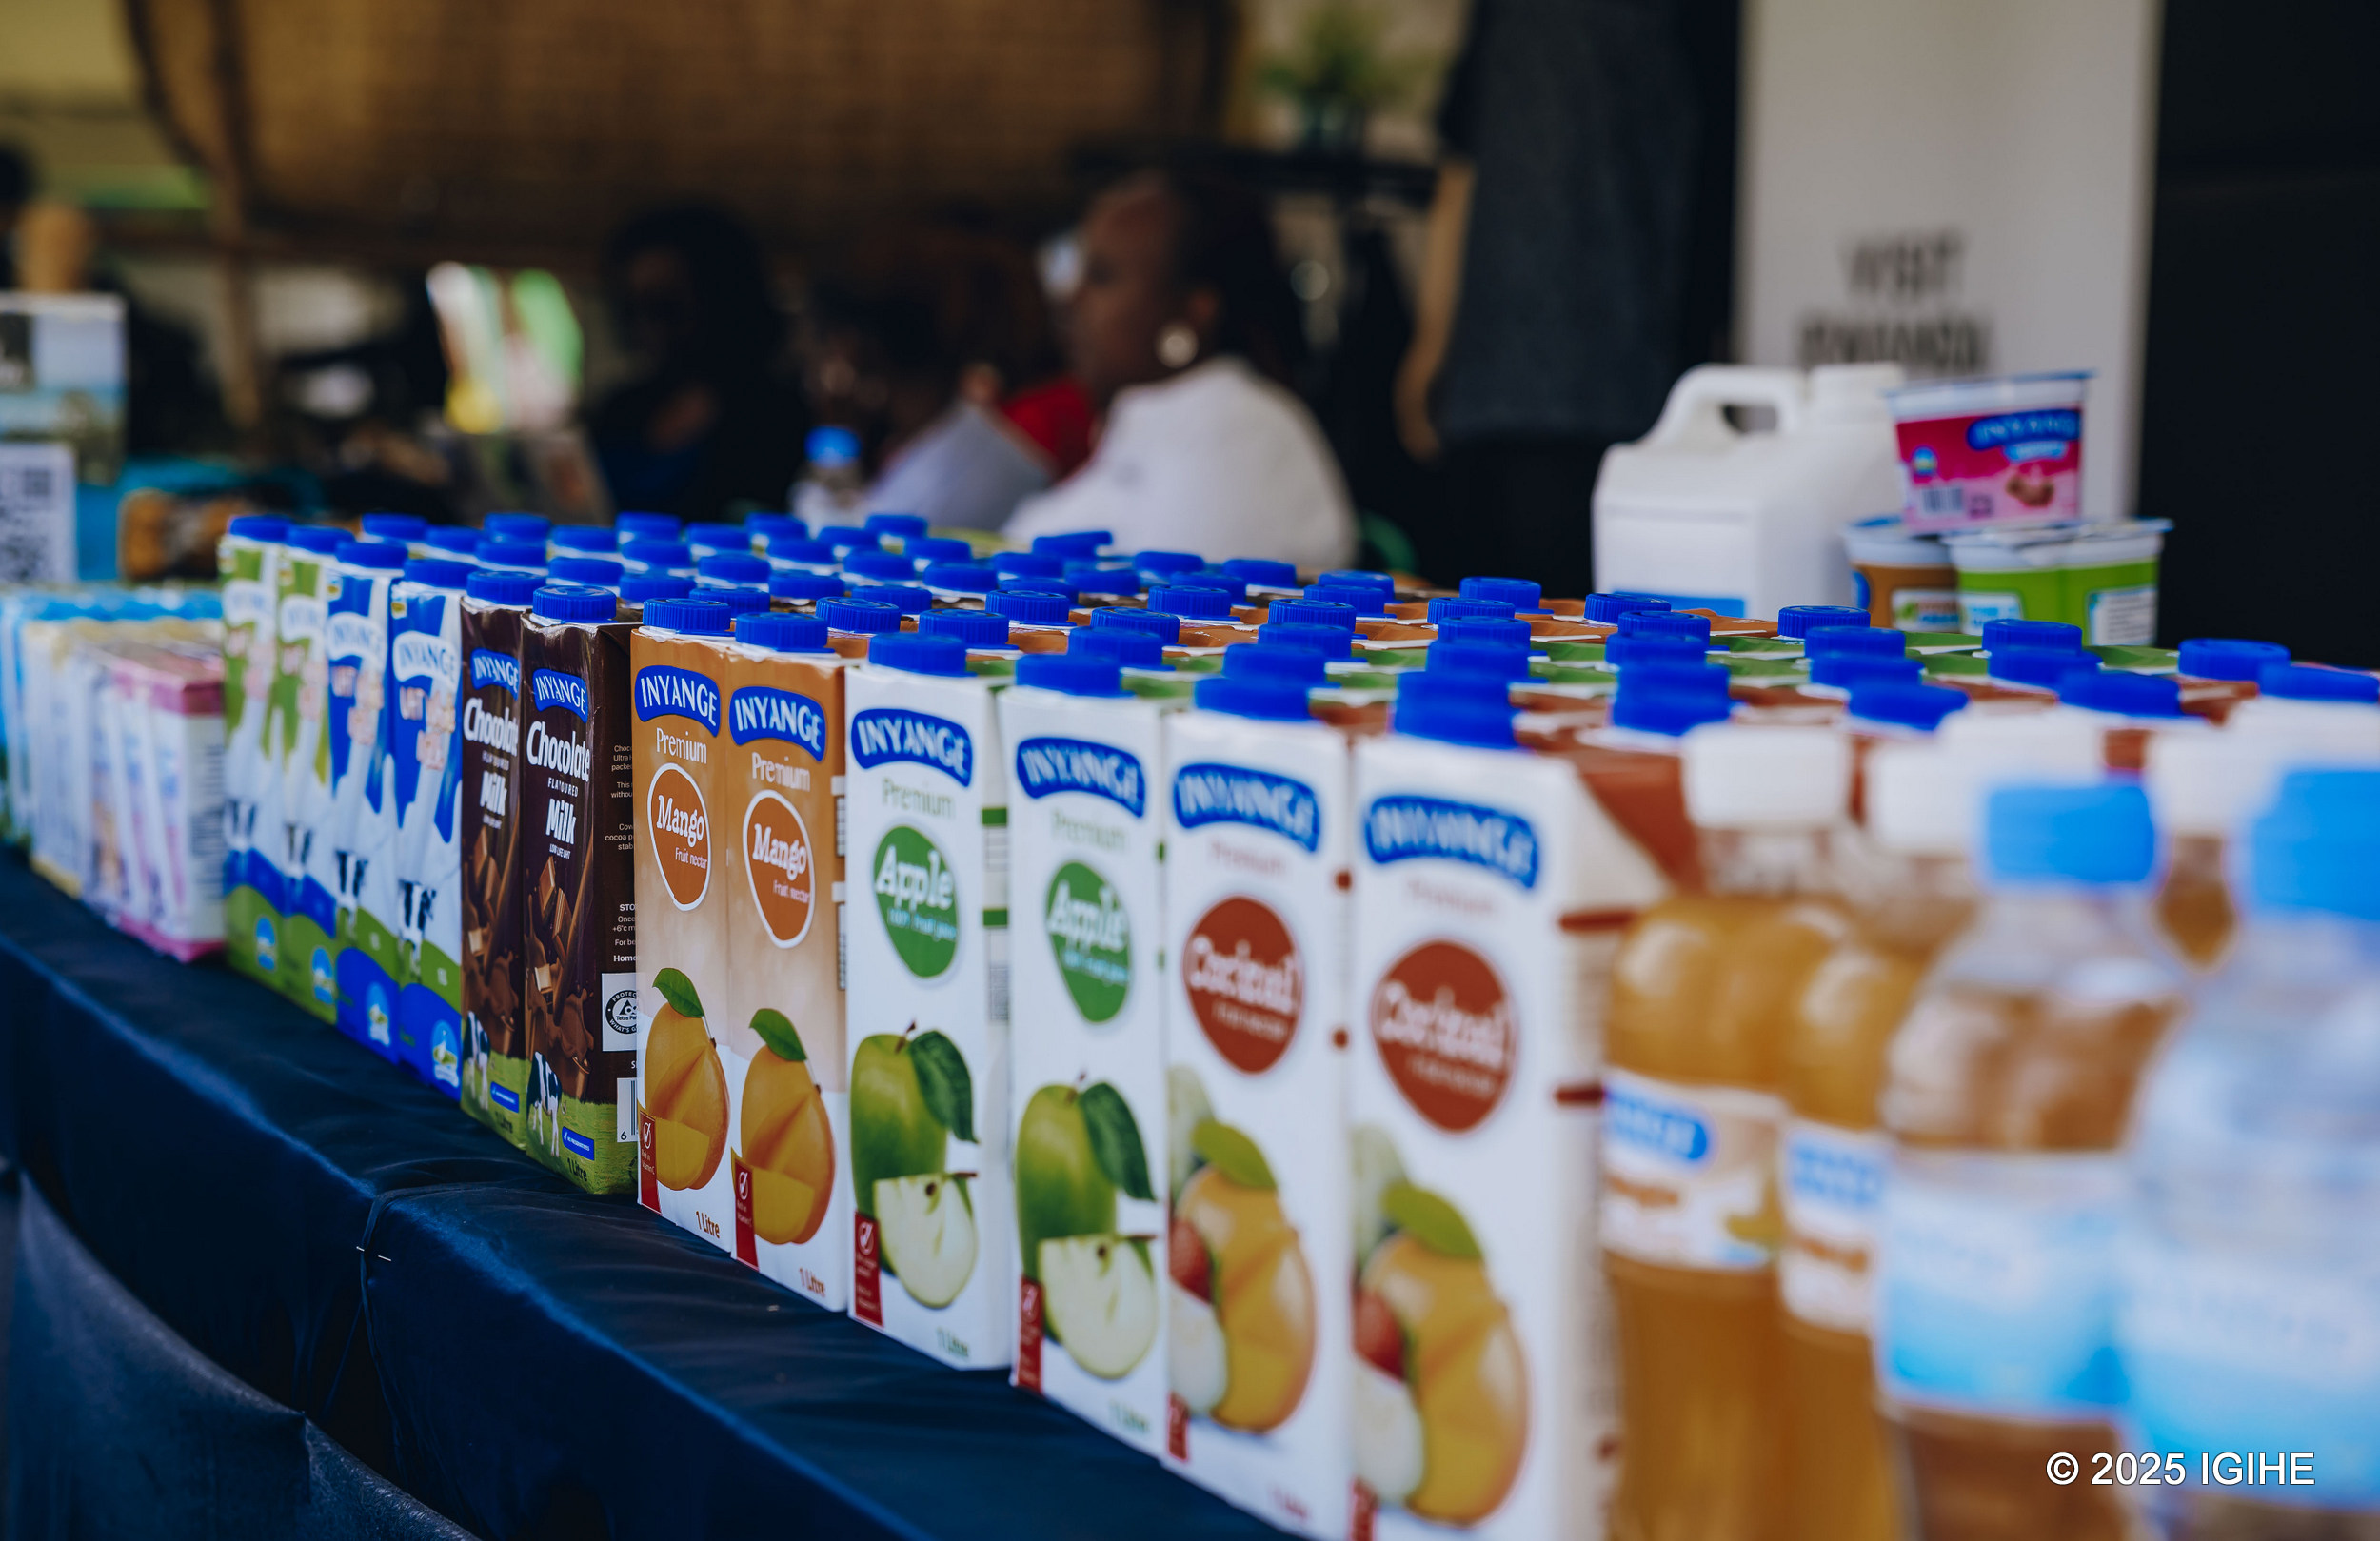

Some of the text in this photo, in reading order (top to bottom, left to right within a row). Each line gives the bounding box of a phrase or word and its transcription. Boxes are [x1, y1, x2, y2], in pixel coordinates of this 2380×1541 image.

[535, 675, 586, 715] INYANGE
[640, 675, 718, 727] INYANGE
[463, 697, 519, 757] Chocolate
[656, 727, 707, 764] Premium
[734, 695, 823, 752] INYANGE
[526, 721, 591, 782] Chocolate
[611, 763, 632, 772] packe
[857, 717, 970, 779] INYANGE
[480, 770, 508, 817] Milk
[751, 752, 811, 792] Premium
[882, 777, 955, 818] Premium
[545, 798, 577, 845] Milk
[656, 795, 704, 848] Mango
[675, 847, 707, 869] Fruit nectar
[752, 823, 807, 881] Mango
[876, 844, 953, 912] Apple
[621, 1131, 627, 1140] 6
[572, 1159, 587, 1182] Litre
[696, 1211, 702, 1229] 1
[702, 1213, 721, 1239] Litre
